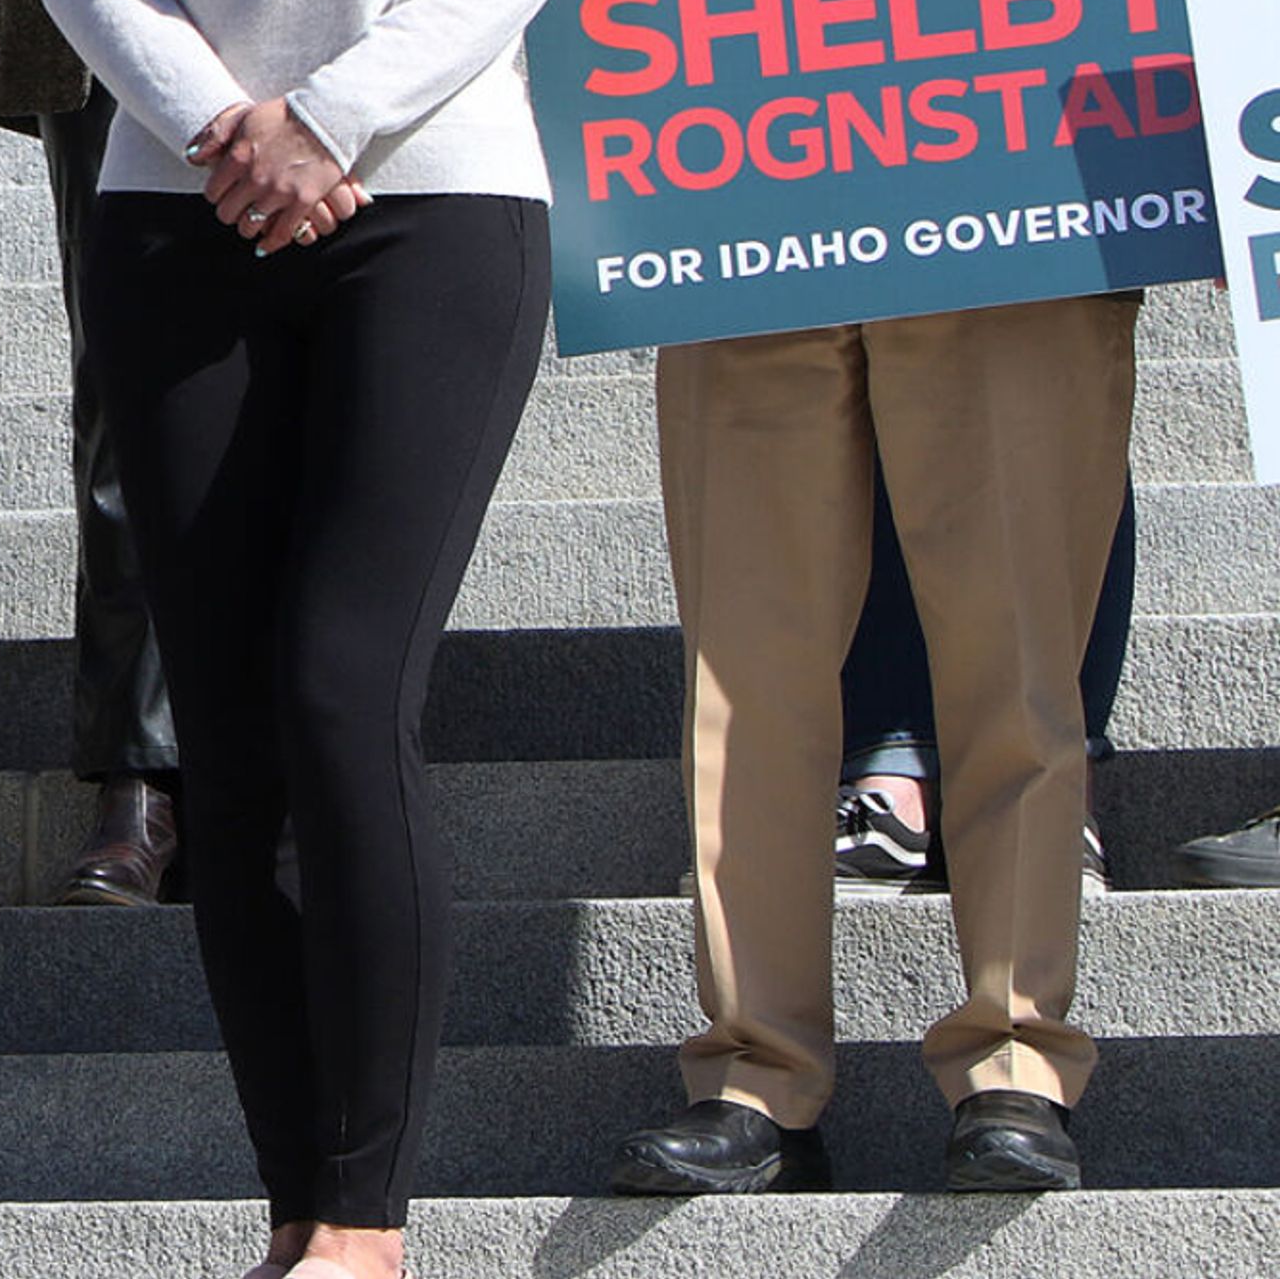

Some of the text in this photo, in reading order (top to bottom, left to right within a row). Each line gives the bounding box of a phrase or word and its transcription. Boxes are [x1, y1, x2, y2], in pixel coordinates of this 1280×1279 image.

[582, 53, 1200, 202] ROGNSTAD
[596, 187, 1208, 293] FOR IDAHO GOVERNOR
